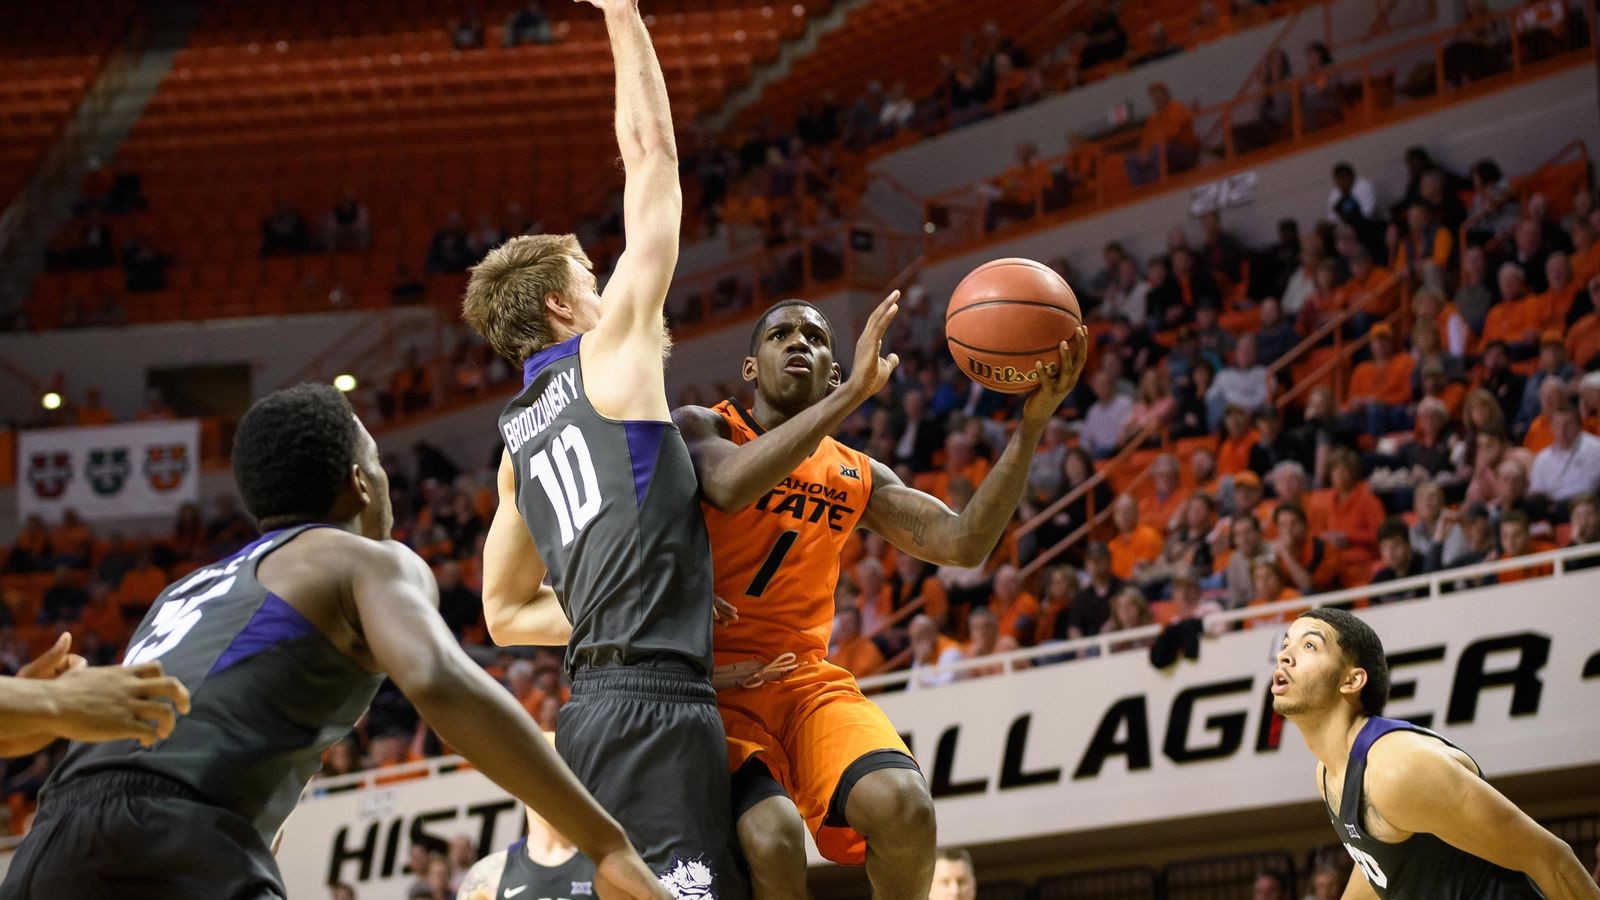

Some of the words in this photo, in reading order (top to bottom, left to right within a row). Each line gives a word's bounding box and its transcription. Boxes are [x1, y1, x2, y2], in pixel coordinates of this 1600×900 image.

[503, 367, 579, 454] BRODZIANSKY
[530, 424, 602, 547] 10
[755, 488, 855, 532] TATE
[776, 477, 848, 502] AHOMA
[745, 531, 799, 597] 1
[328, 799, 528, 886] HIST
